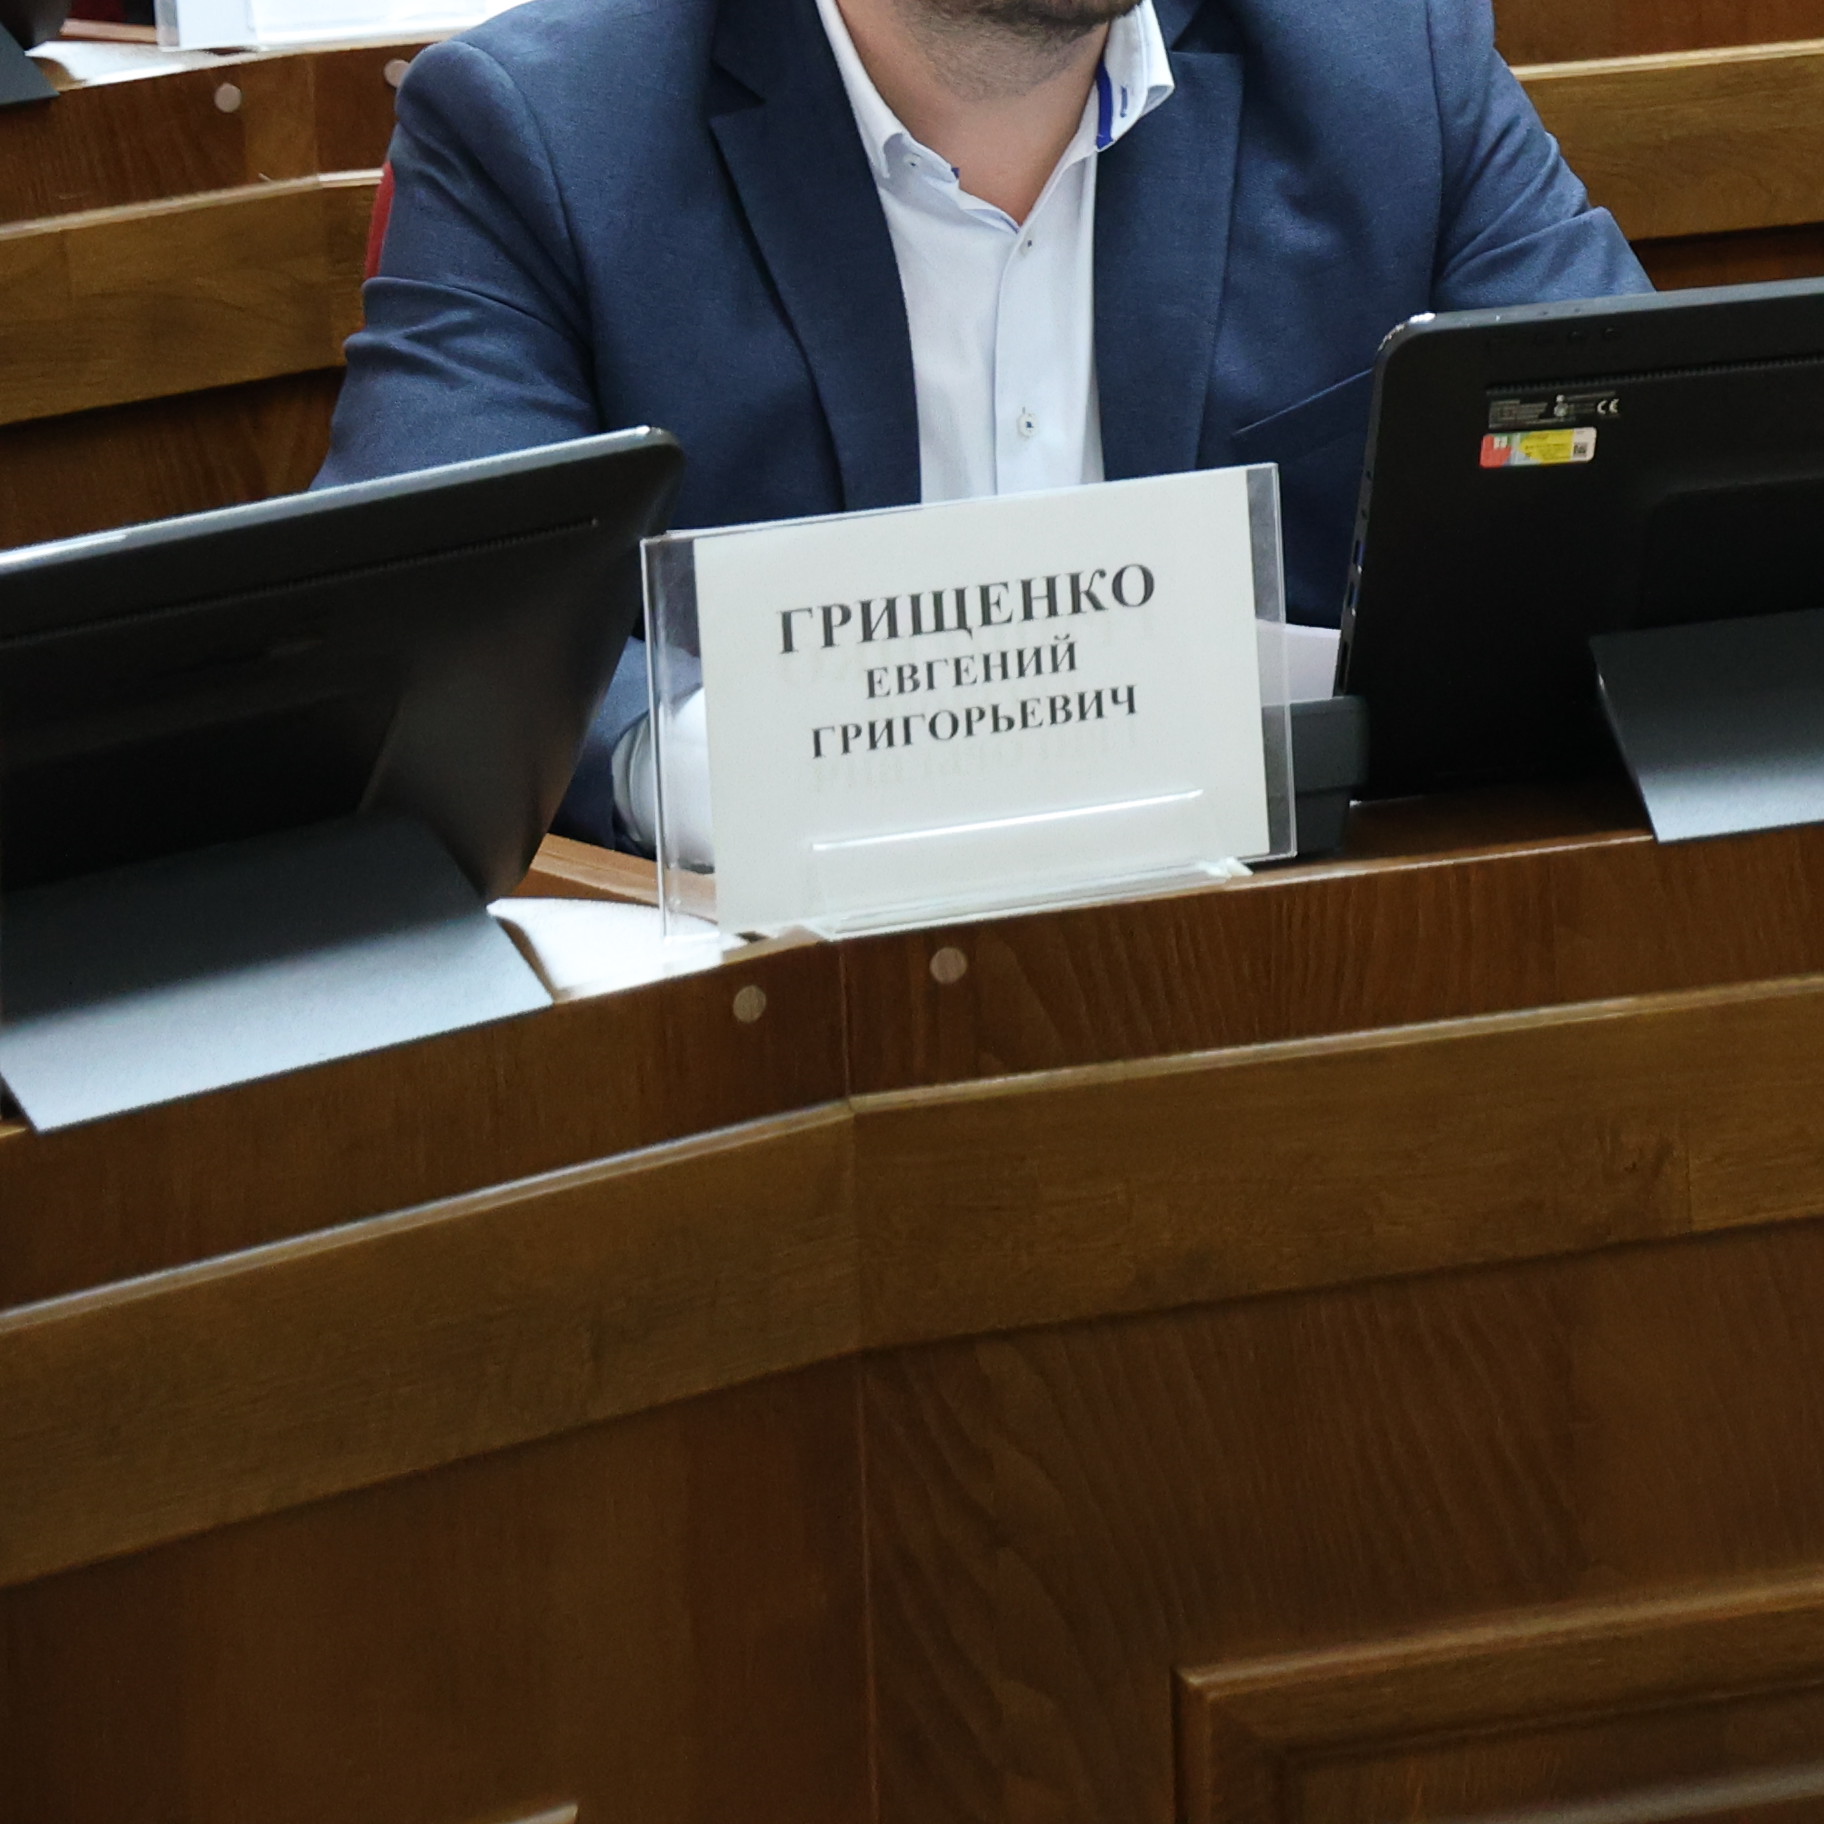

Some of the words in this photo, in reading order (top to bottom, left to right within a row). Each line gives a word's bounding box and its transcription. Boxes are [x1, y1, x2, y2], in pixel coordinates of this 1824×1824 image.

[778, 562, 1157, 655] ГРИЩЕНКО
[864, 635, 1079, 700] ЕВГЕНИЙ
[810, 684, 1139, 759] ГРИГОРЬЕВИЧ
